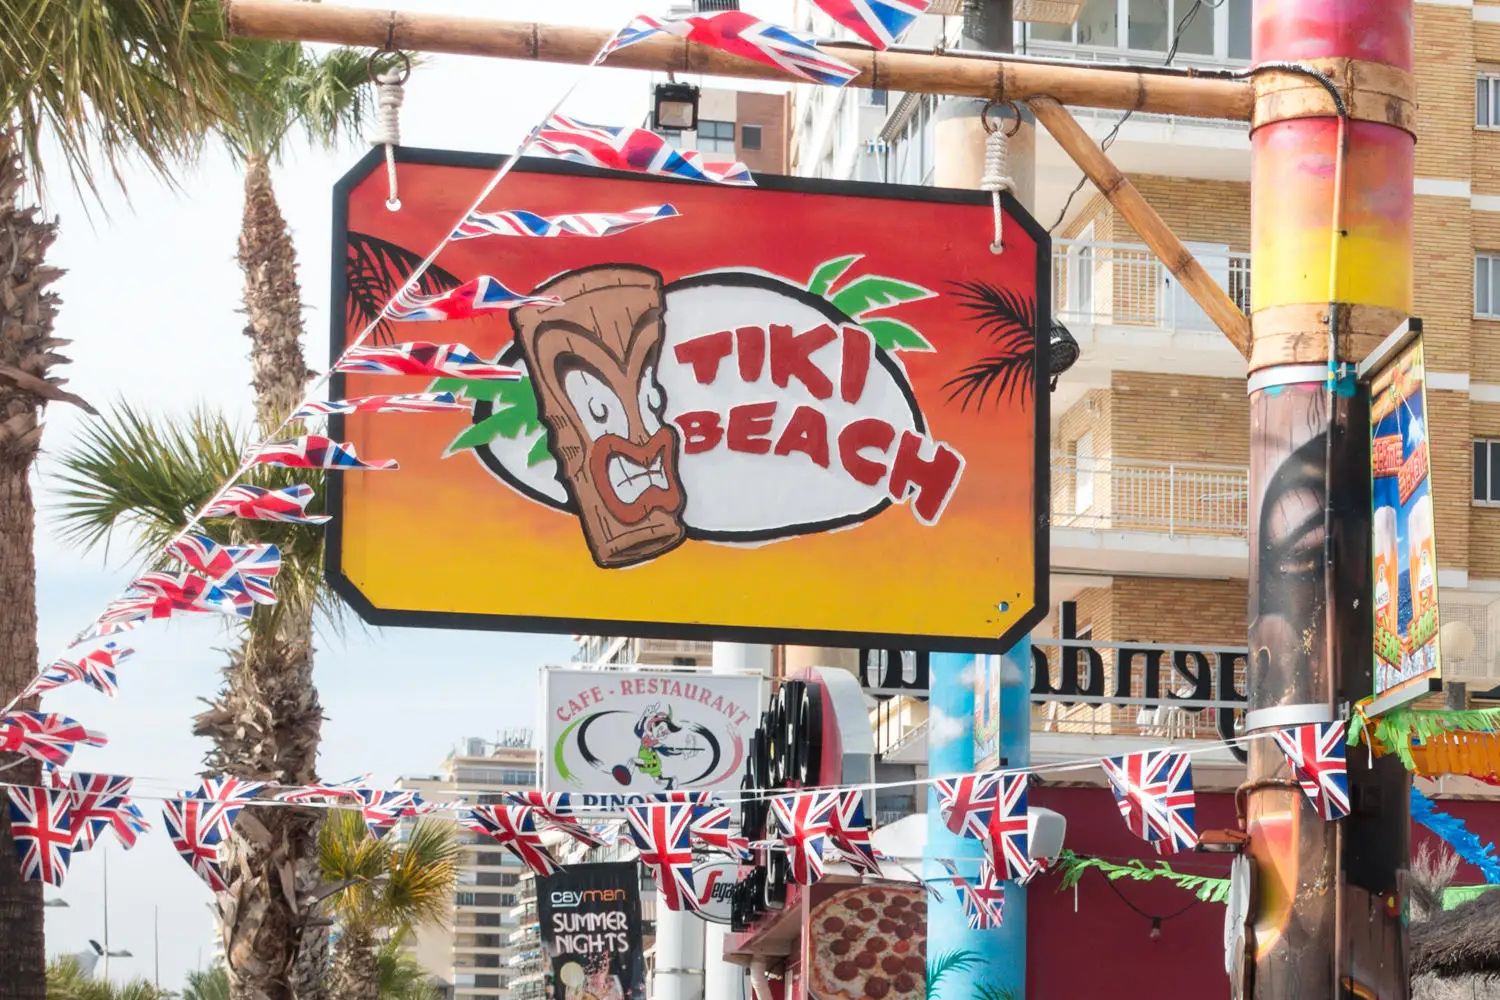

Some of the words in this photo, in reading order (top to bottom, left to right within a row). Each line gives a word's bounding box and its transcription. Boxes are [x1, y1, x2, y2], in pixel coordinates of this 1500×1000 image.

[673, 322, 872, 406] TIKI
[673, 400, 966, 523] BEACH
[556, 686, 604, 721] CAFE
[620, 678, 751, 726] RESTAURANT
[551, 888, 626, 907] cayman
[552, 911, 629, 933] SUMMER
[555, 932, 630, 954] NIGHTS
